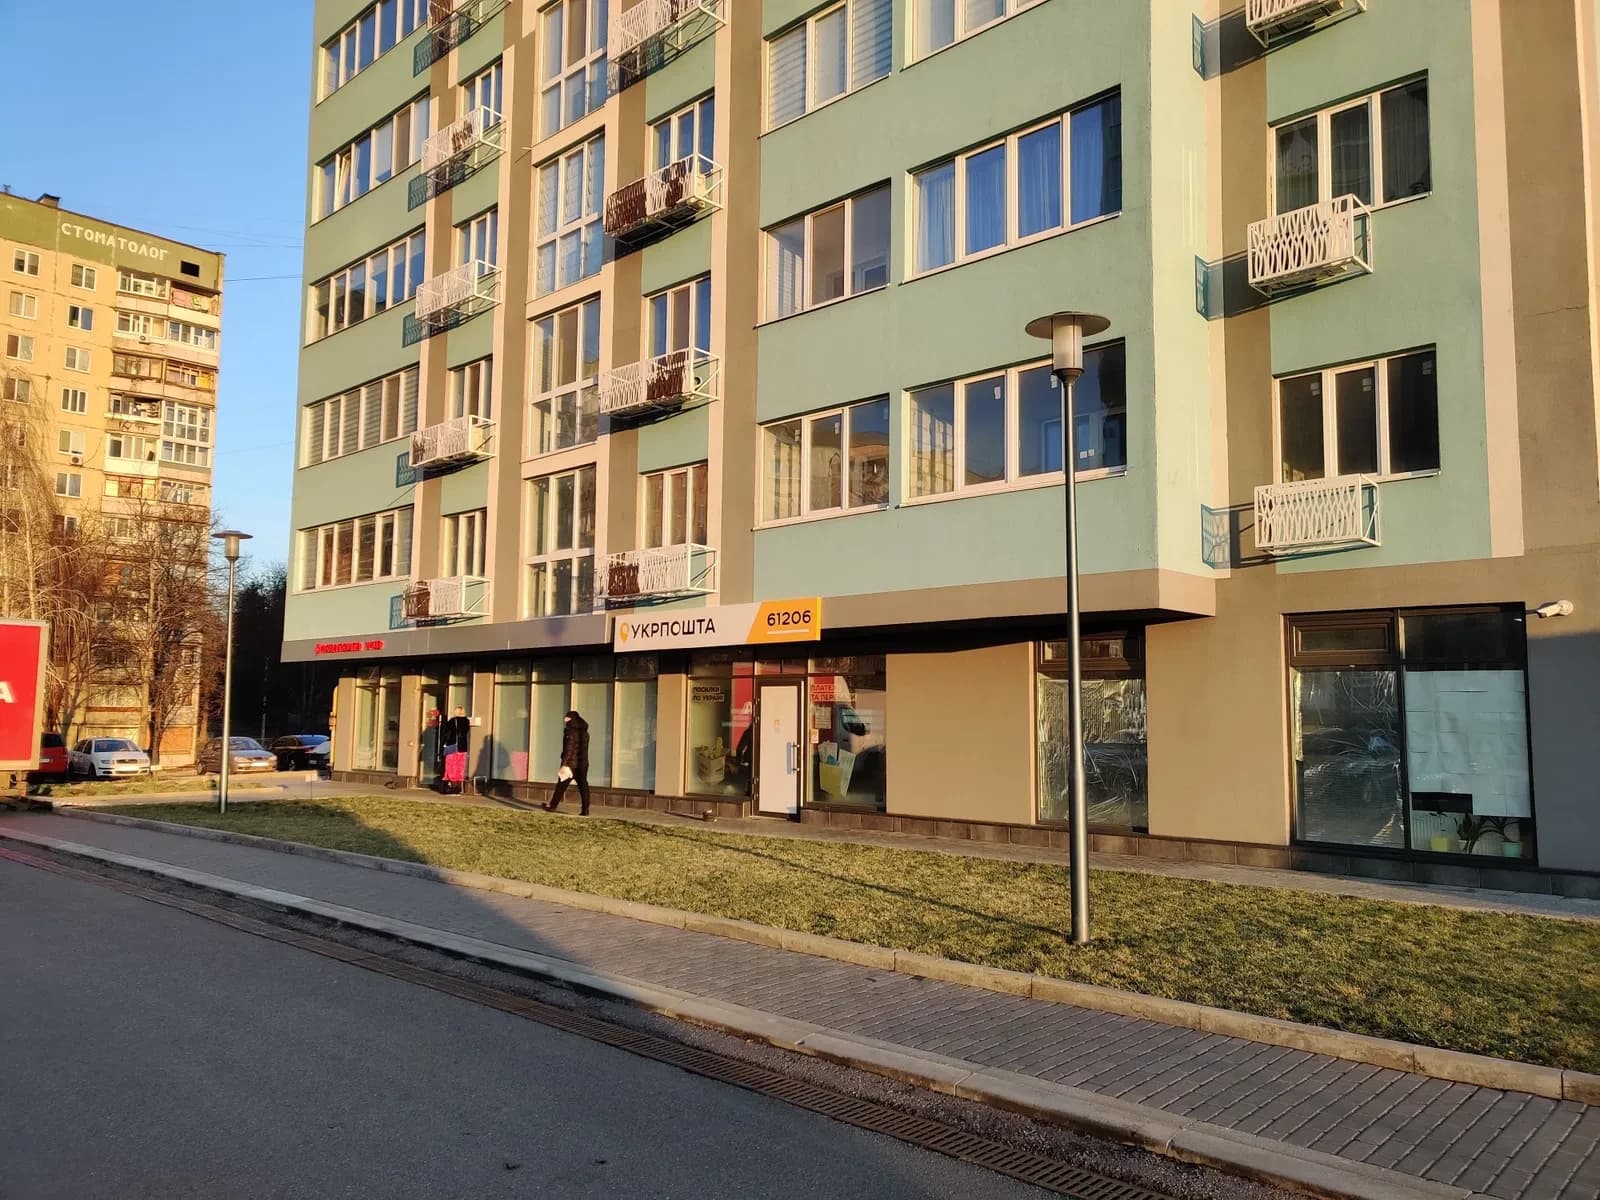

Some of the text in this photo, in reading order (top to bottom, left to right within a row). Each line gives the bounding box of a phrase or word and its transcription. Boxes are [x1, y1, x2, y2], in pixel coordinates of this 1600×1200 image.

[61, 222, 169, 261] СТОМАТОЛОГ
[631, 609, 811, 639] УКРПОШТА 61206
